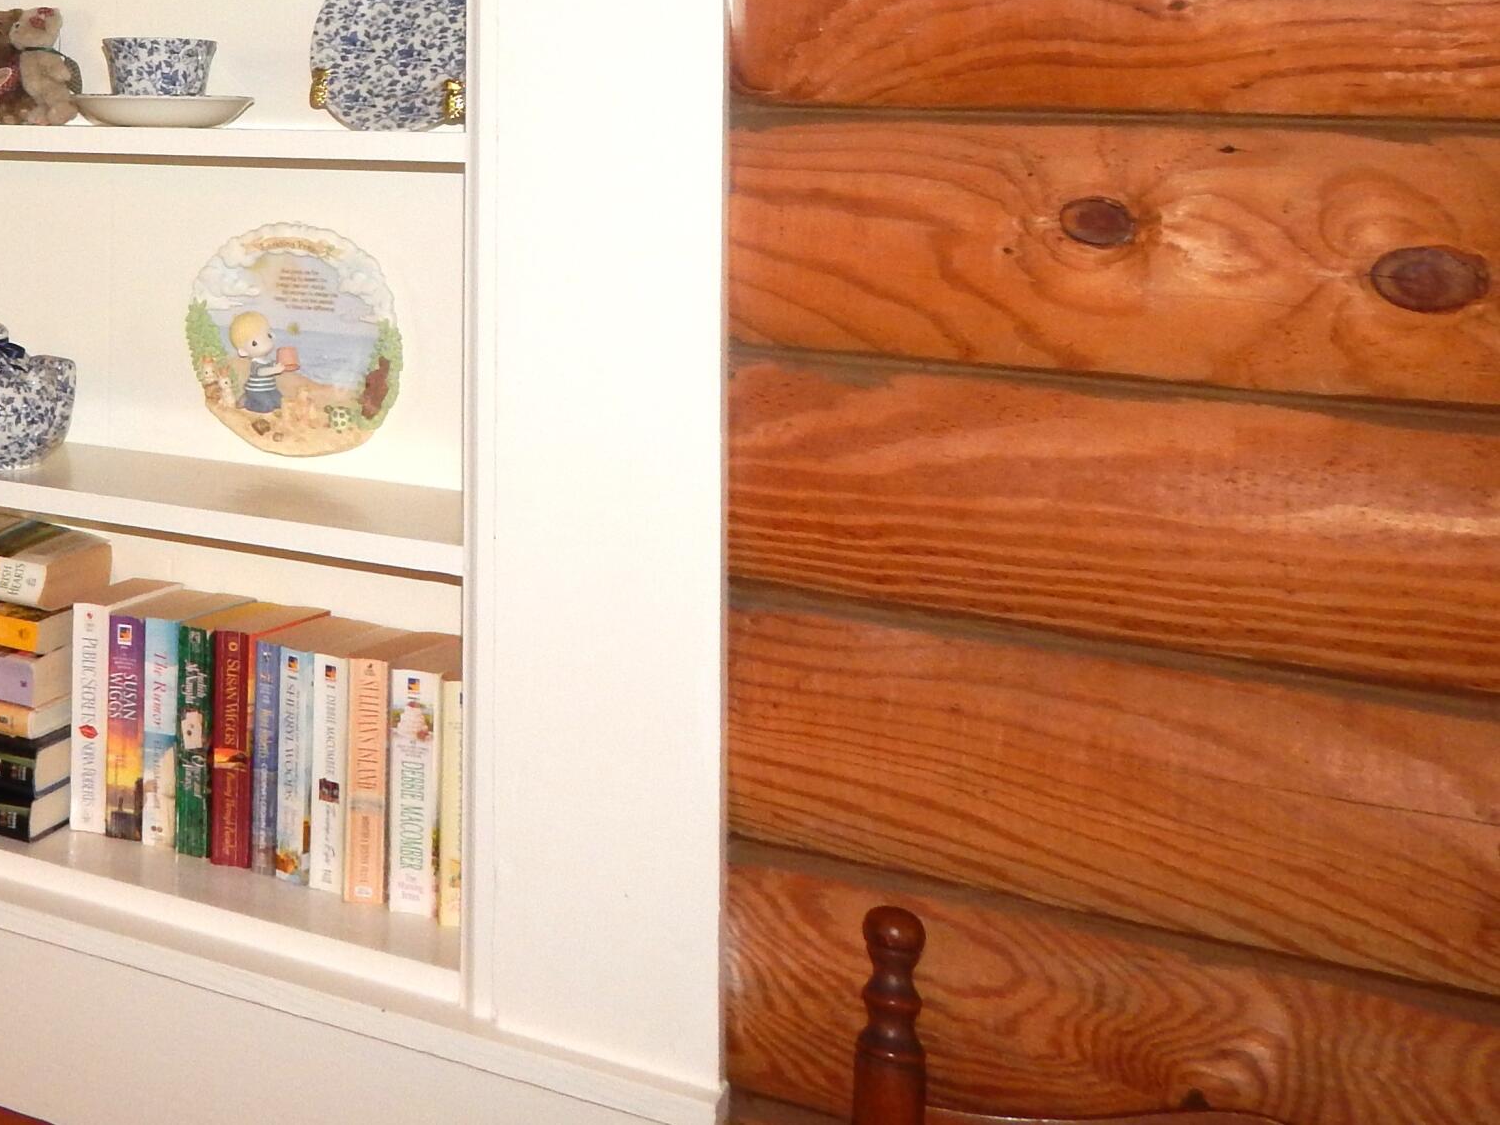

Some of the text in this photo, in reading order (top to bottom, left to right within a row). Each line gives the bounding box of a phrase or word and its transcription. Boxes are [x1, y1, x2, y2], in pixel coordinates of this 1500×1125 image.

[8, 563, 26, 595] HEARTS
[80, 637, 98, 725] PUBLIC SECRETS
[154, 653, 168, 676] The
[109, 672, 123, 719] WIGGS
[122, 673, 138, 720] SUSAN
[154, 680, 168, 728] Rumor
[224, 659, 241, 745] SUSAN WIGGS
[284, 684, 296, 744] SHERRYL
[325, 694, 336, 777] DEBBIE MACOMBER
[357, 679, 381, 790] SULLIVAN'S ISLAND
[82, 741, 97, 807] NORA ROBERTS
[283, 747, 295, 801] WOODS
[400, 761, 424, 801] DEBBIE
[399, 804, 424, 871] MACOMBER
